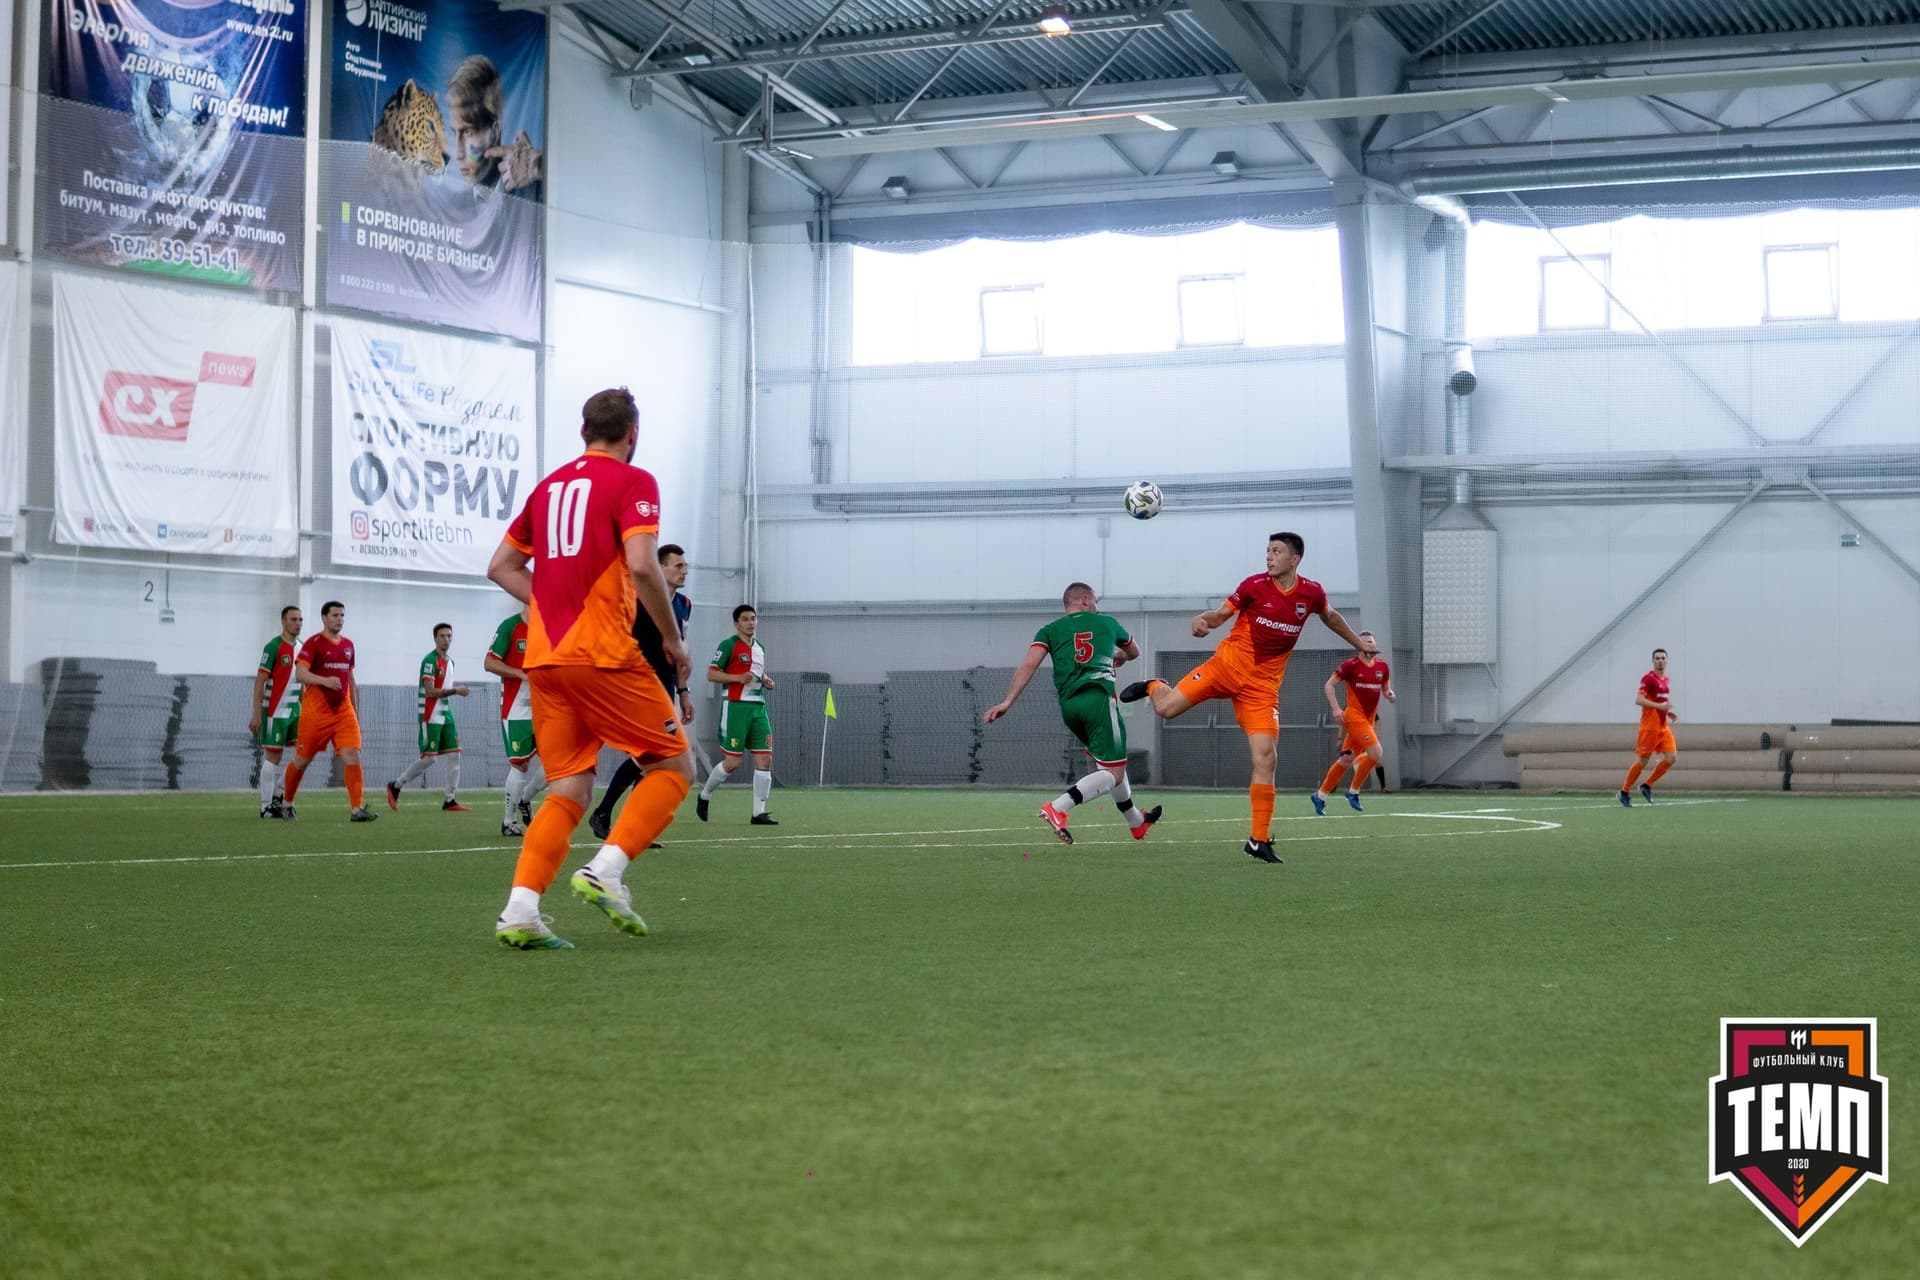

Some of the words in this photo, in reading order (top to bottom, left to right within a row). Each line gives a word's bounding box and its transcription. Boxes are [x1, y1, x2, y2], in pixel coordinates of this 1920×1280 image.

[69, 9, 150, 49] Энергия
[368, 10, 427, 42] ЛИЗИНГ
[121, 52, 218, 90] движения
[192, 94, 206, 111] к
[207, 96, 290, 128] победам!
[83, 170, 148, 199] Поставка
[151, 189, 267, 220] нефтепродуктов:
[59, 189, 106, 216] битум,
[109, 202, 152, 224] мазут,
[156, 211, 201, 232] нефть,
[204, 220, 230, 236] диз.
[233, 225, 286, 245] топливо
[357, 205, 463, 245] СОРЕВНОВАНИЕ
[161, 237, 239, 272] 39-51-41
[356, 231, 367, 246] В
[369, 234, 433, 262] ПРИРОДЕ
[436, 243, 495, 273] БИЗНЕСА
[208, 360, 247, 378] news
[350, 452, 519, 520] ФОРМУ
[371, 517, 473, 544] sportlifebrn
[547, 478, 592, 559] 10
[144, 580, 154, 602] 2
[1074, 632, 1094, 663] 5
